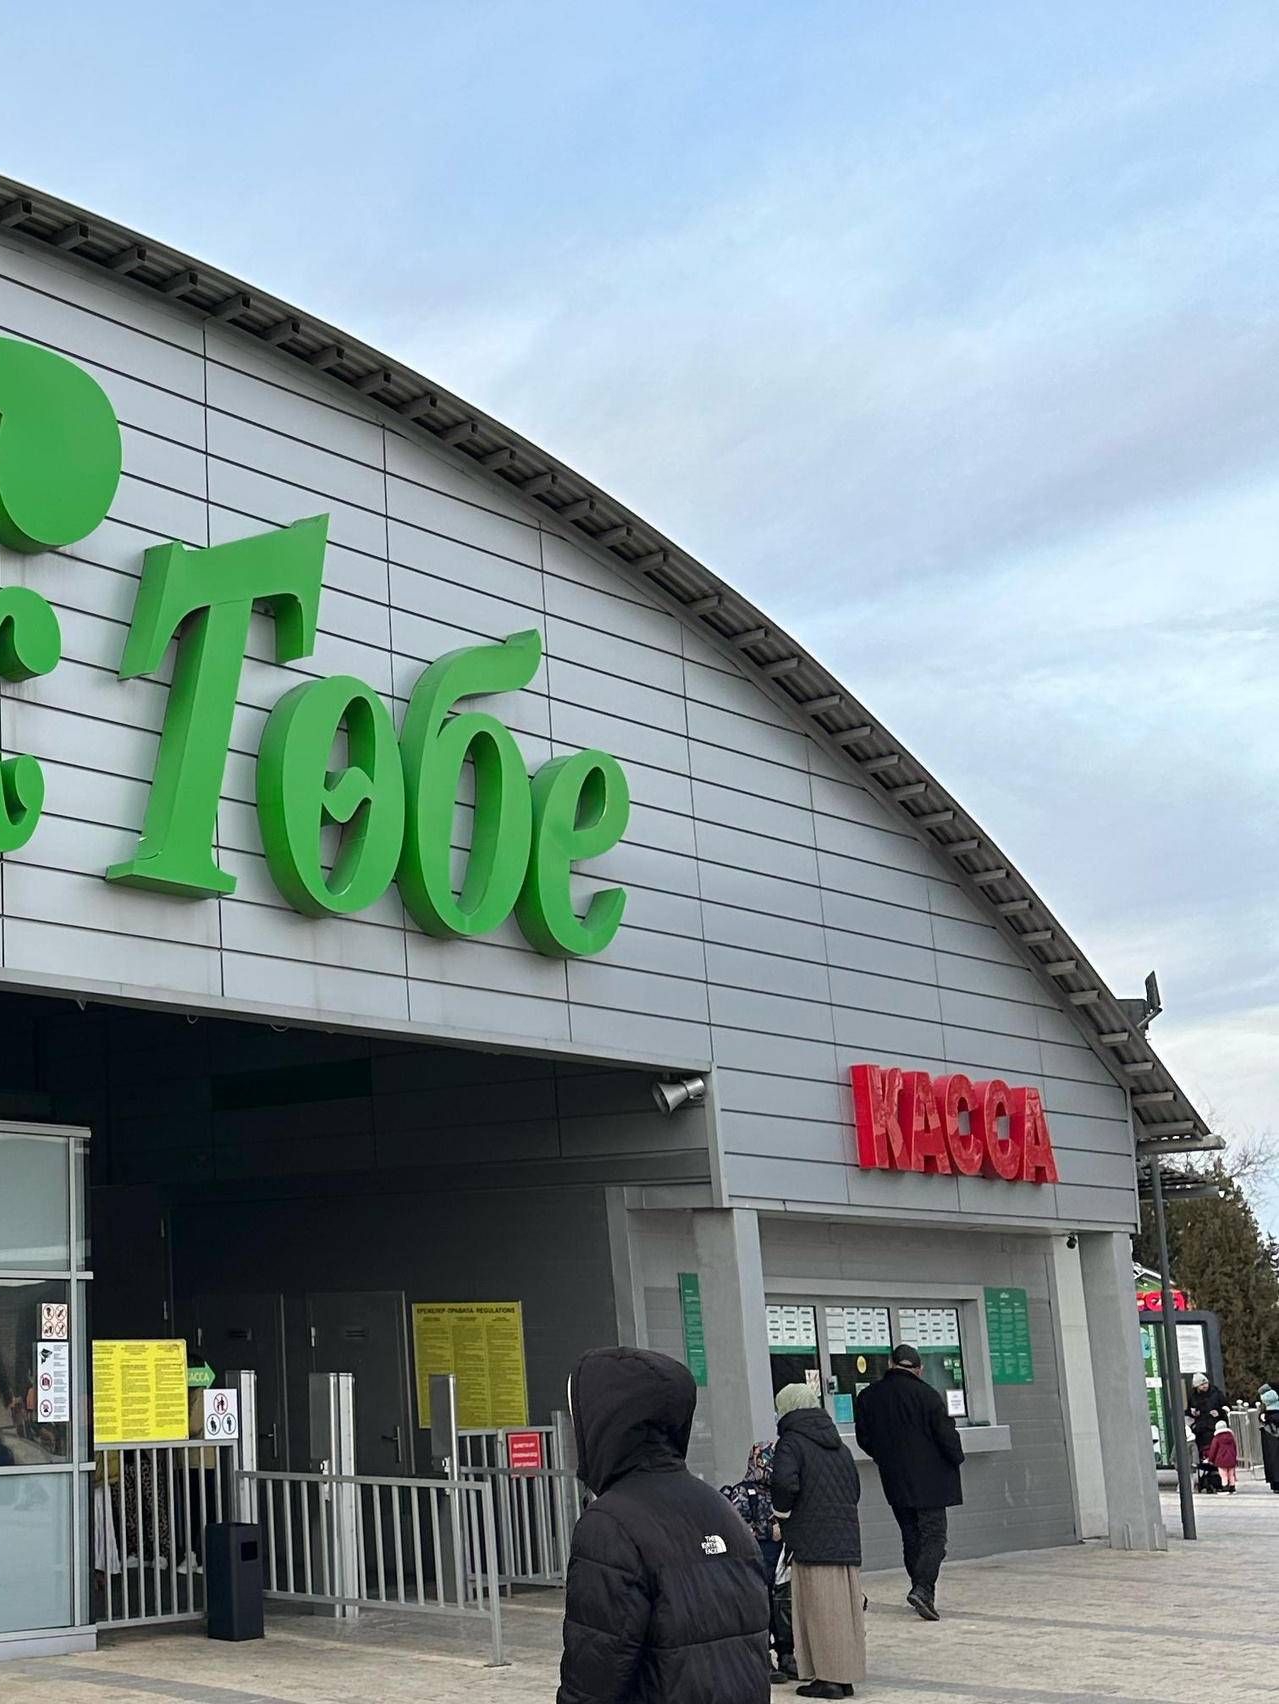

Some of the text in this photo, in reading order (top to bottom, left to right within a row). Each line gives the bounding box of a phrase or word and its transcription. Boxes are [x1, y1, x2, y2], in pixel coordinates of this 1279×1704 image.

[108, 515, 630, 956] Төбе
[850, 1064, 1059, 1183] КАССА
[187, 1371, 210, 1382] АССА
